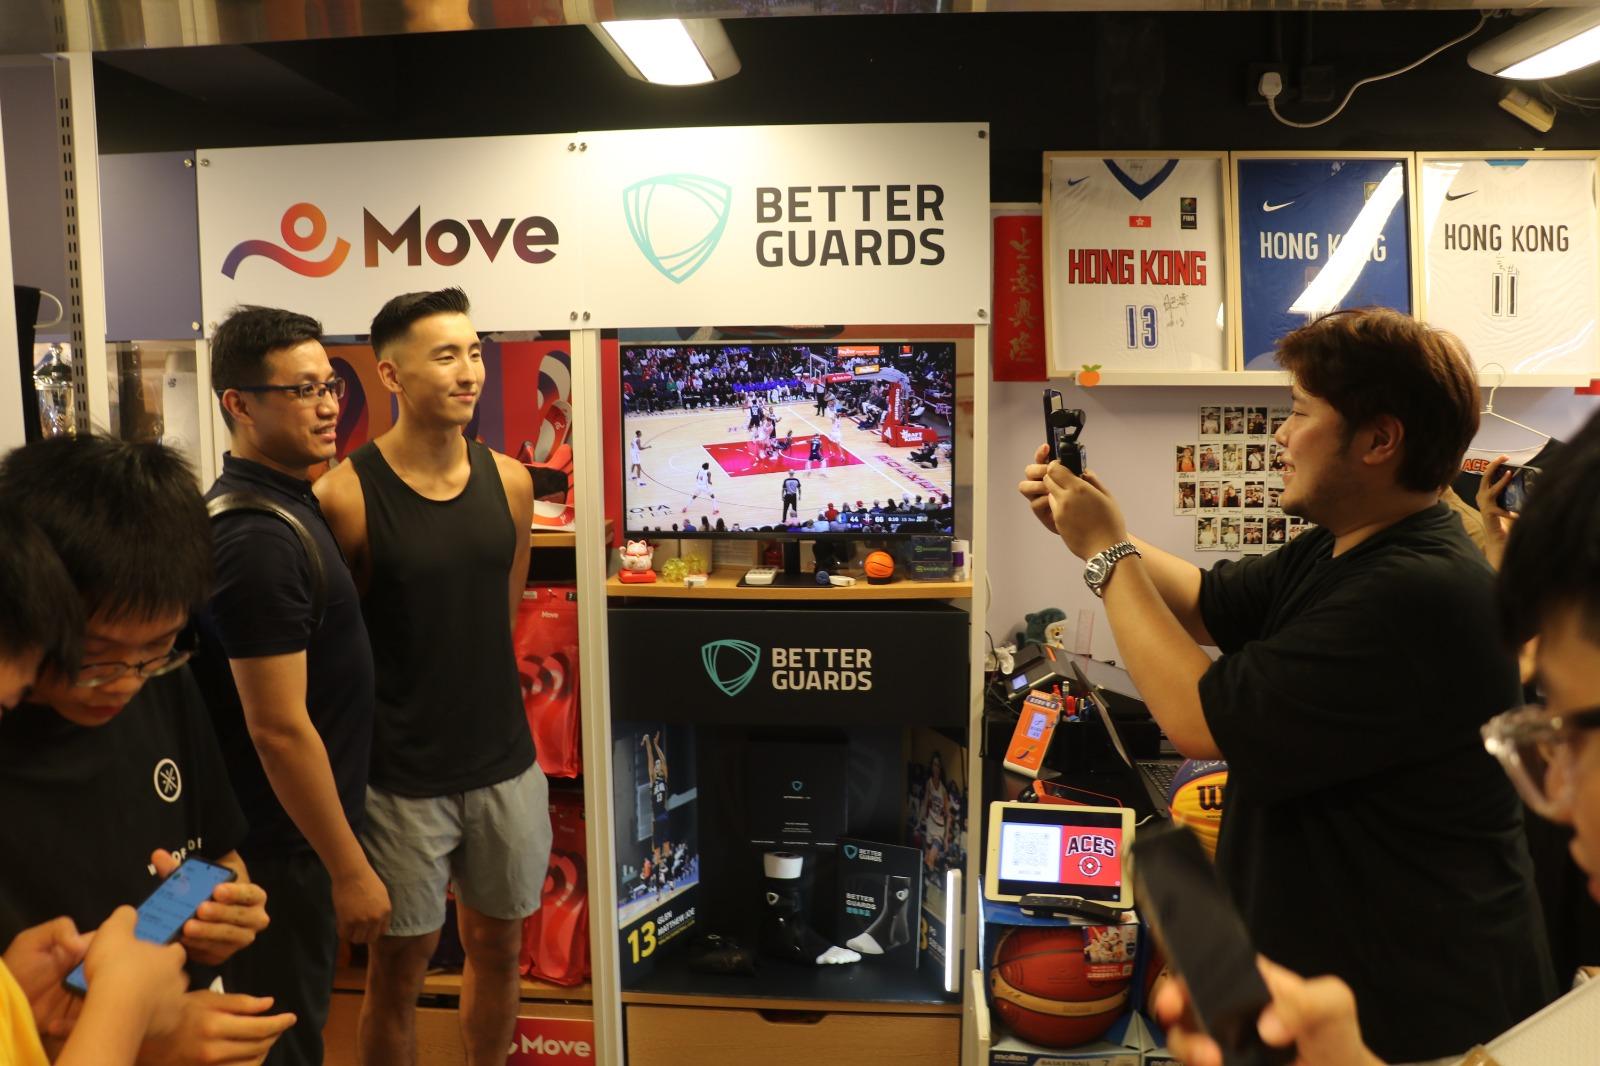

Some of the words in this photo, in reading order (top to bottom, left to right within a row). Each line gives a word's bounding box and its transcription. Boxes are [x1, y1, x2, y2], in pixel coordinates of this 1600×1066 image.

[756, 184, 945, 223] BETTER
[363, 205, 559, 268] Move
[756, 228, 945, 267] GUARDS
[1260, 231, 1319, 261] HONG
[1327, 233, 1387, 262] KG
[1444, 223, 1502, 251] HONG
[1512, 225, 1569, 252] KONG
[1068, 249, 1135, 285] HONG
[1140, 250, 1207, 286] KONG
[1492, 272, 1518, 317] 11
[1126, 304, 1159, 349] 13
[772, 648, 872, 669] BETTER
[771, 670, 873, 691] GUARDS
[1065, 834, 1116, 857] ACES
[846, 892, 875, 903] BETTER
[846, 900, 877, 910] GUARDS
[627, 920, 657, 964] 13
[520, 1033, 592, 1057] Move
[994, 1053, 1028, 1062] molten
